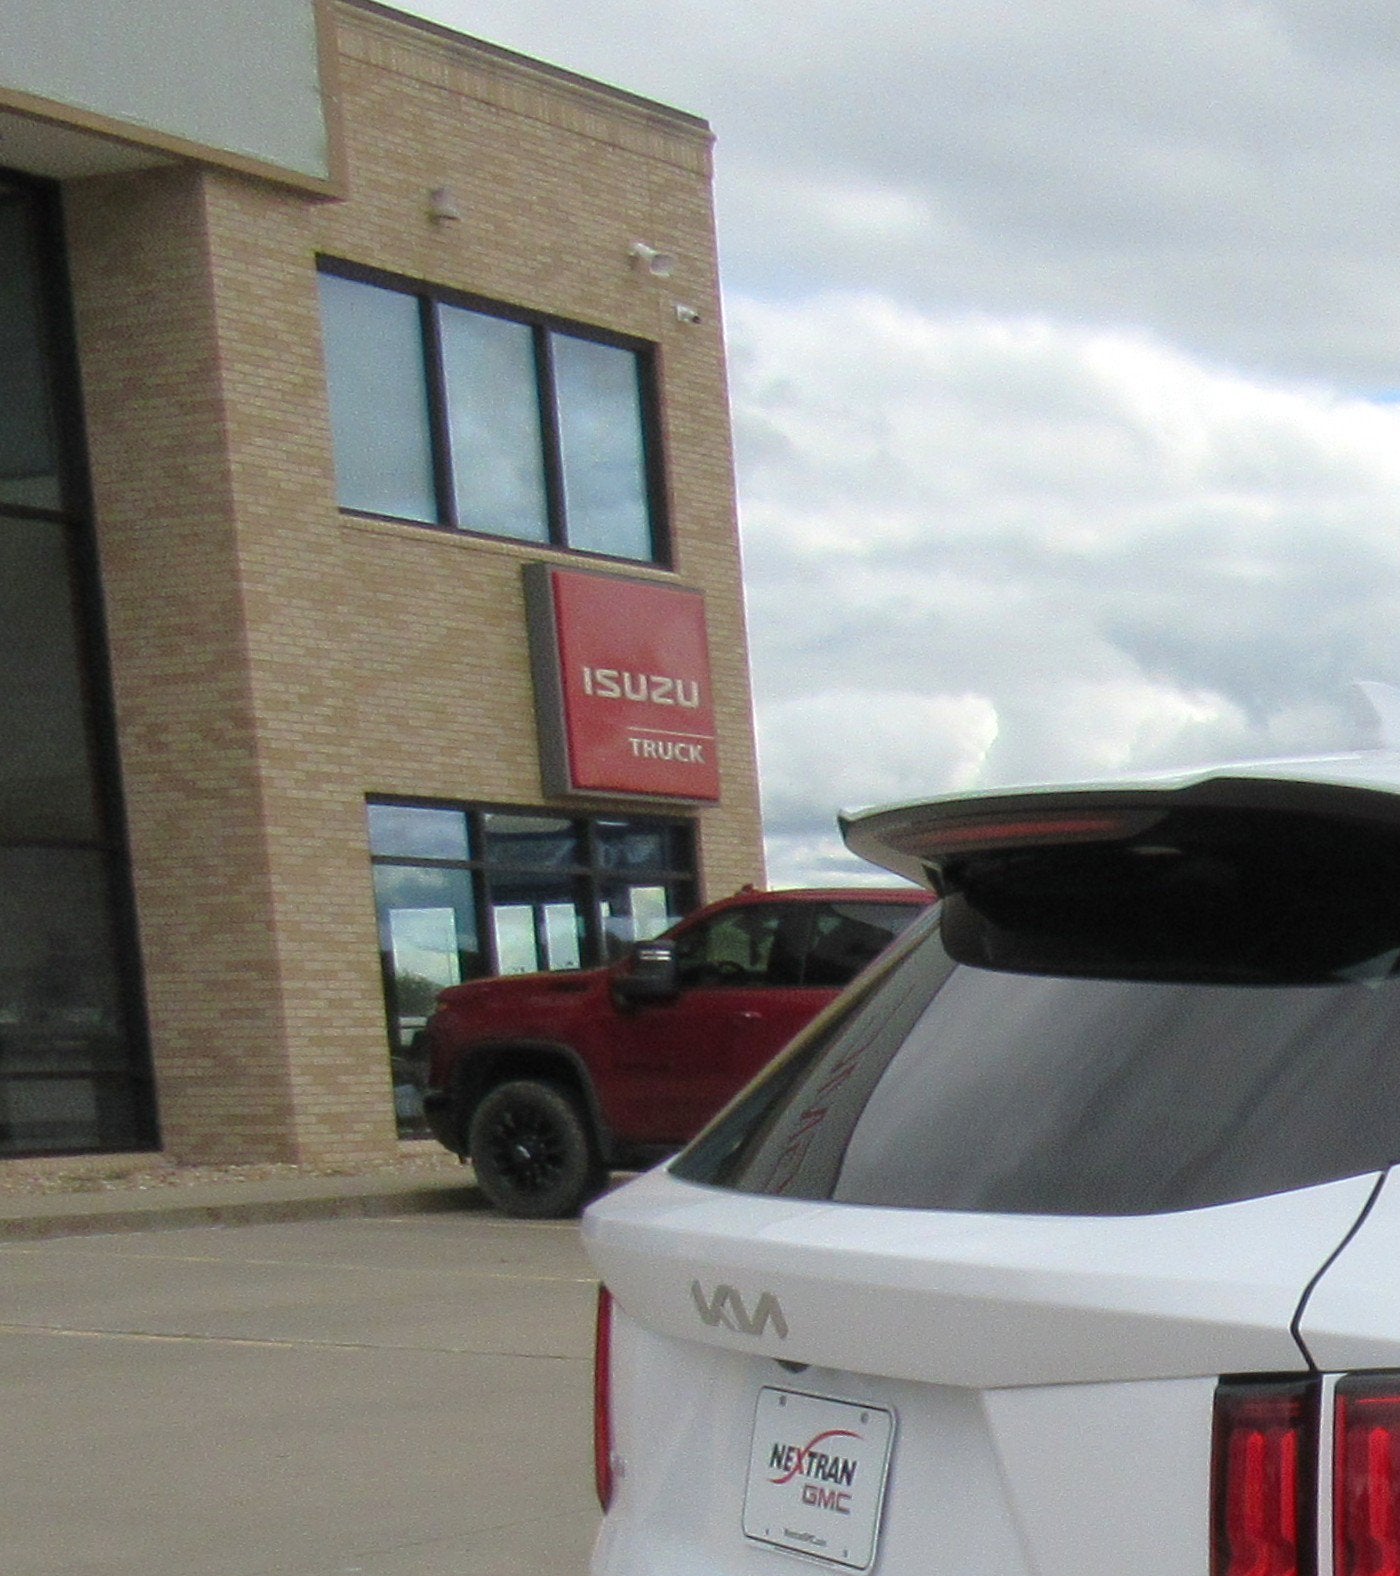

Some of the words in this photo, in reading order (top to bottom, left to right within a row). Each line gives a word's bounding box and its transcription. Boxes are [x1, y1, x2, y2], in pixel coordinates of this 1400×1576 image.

[582, 666, 700, 709] ISUZU
[628, 737, 706, 764] TRUCK
[769, 1443, 857, 1487] NEXTRAN
[802, 1484, 853, 1515] GMC
